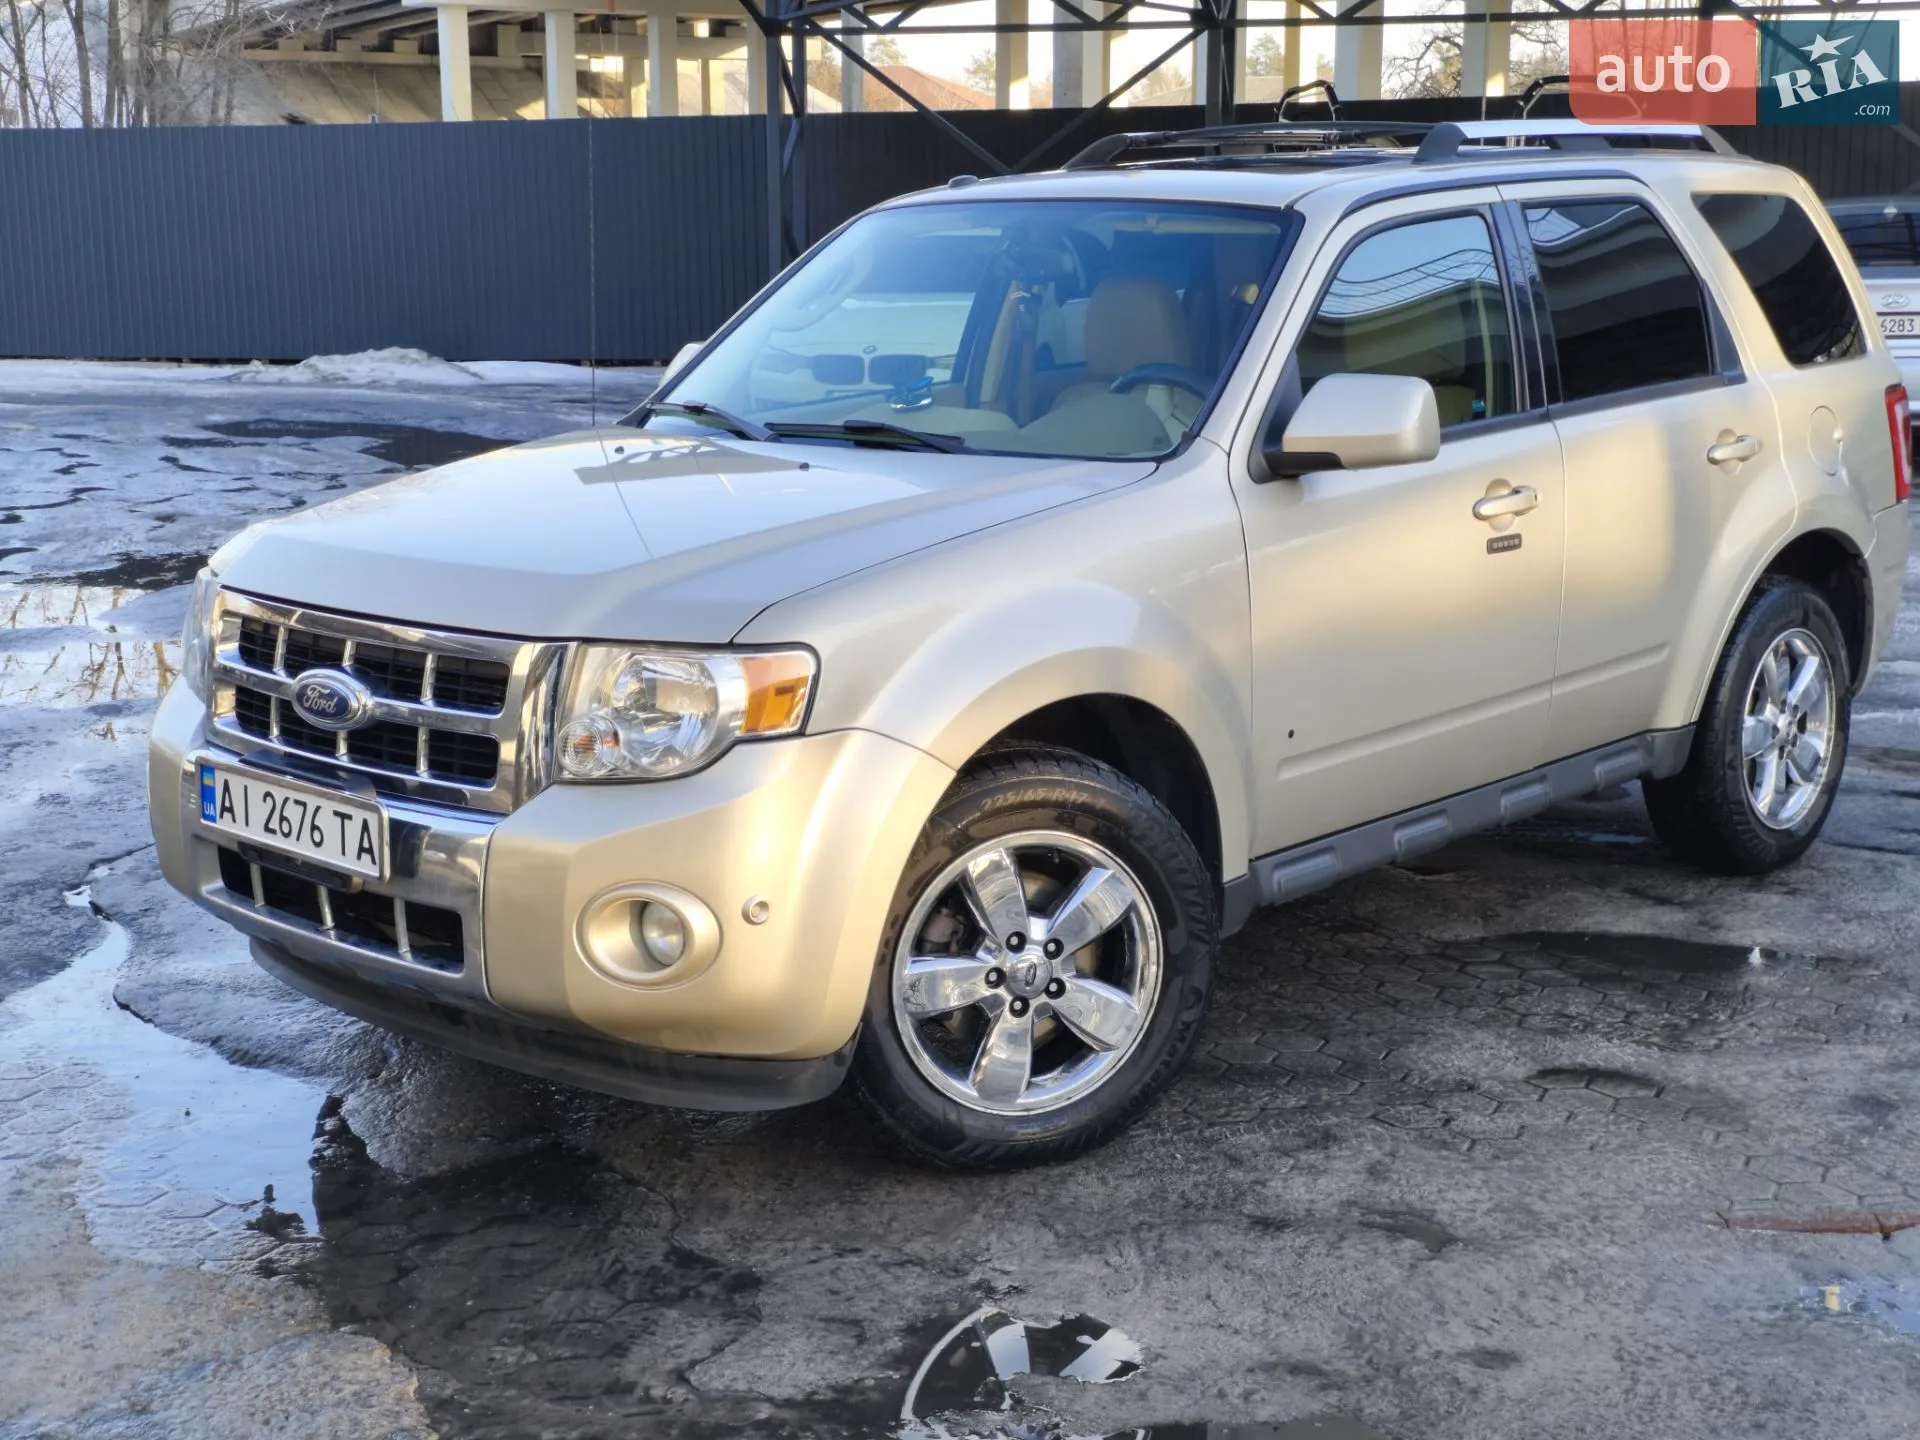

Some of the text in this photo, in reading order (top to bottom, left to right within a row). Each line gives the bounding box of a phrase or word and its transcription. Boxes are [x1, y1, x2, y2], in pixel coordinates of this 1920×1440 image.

[303, 684, 339, 714] Ford
[203, 802, 216, 817] UA
[219, 778, 377, 866] AI 2676 TA
